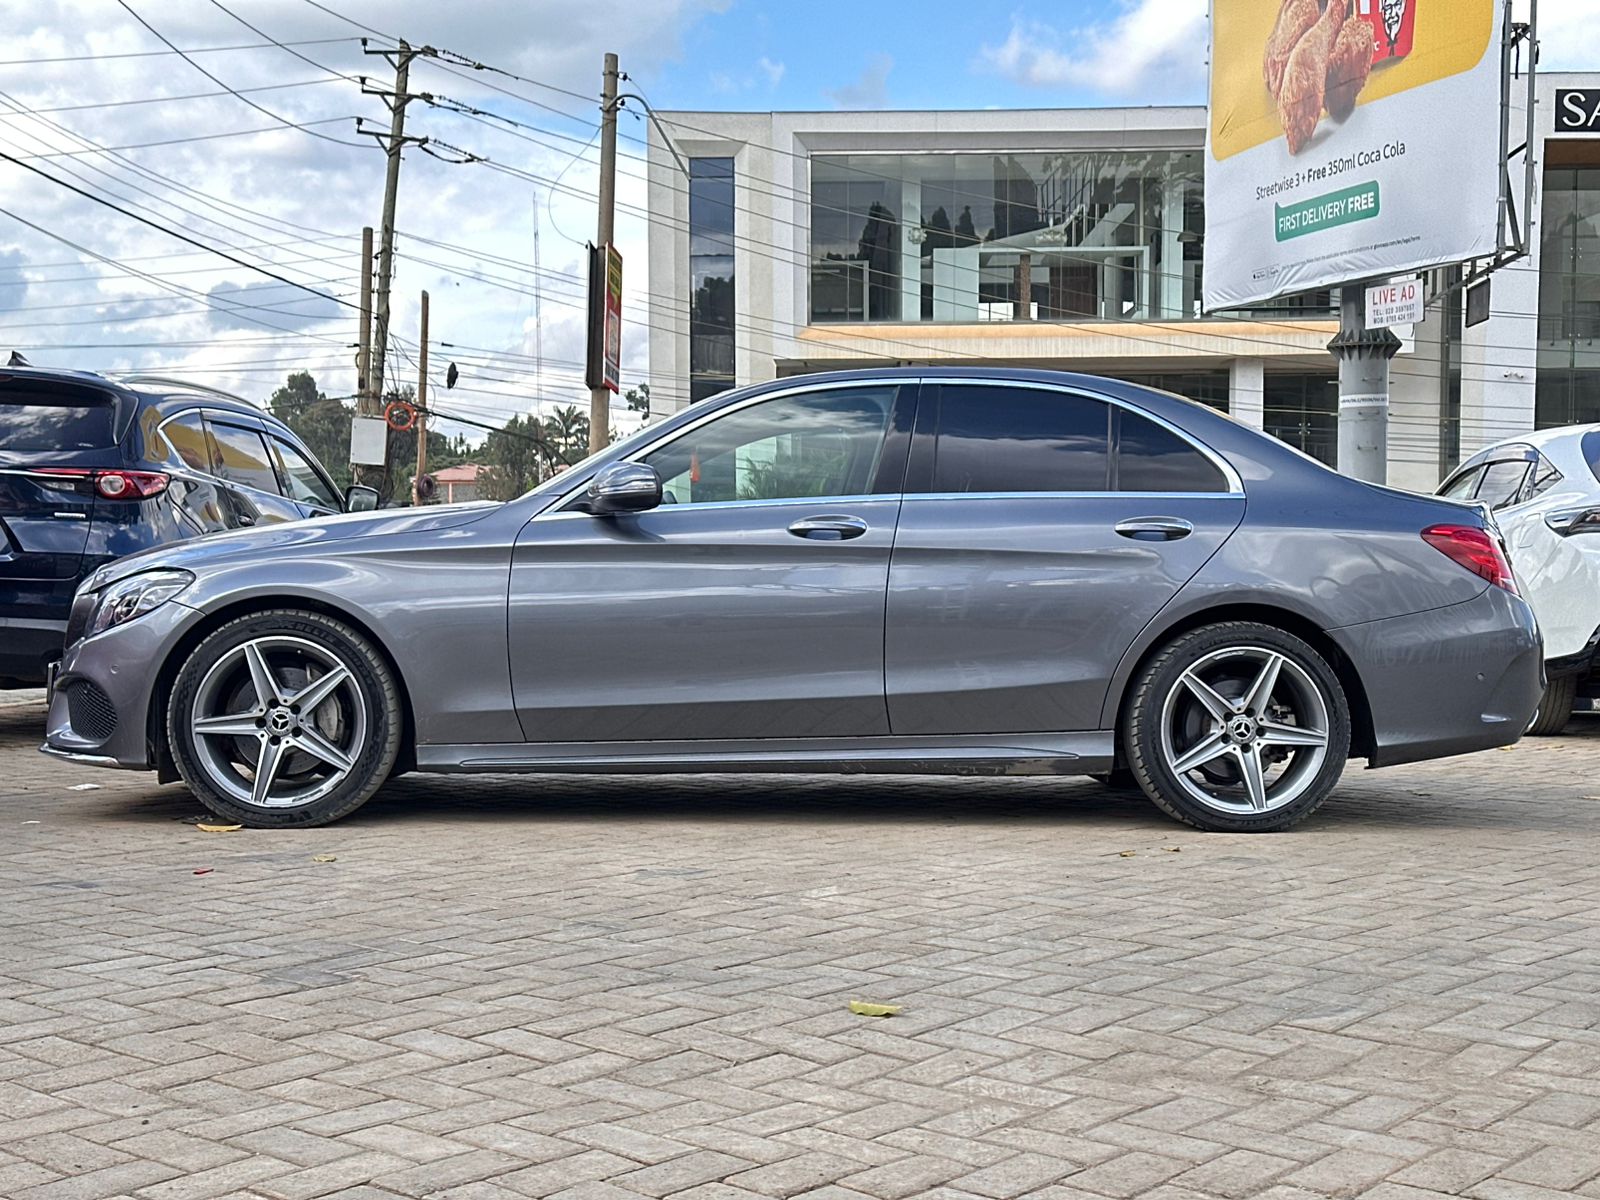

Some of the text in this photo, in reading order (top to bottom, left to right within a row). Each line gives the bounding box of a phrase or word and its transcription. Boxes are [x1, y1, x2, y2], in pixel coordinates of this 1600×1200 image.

[1256, 141, 1406, 200] Streetwise 3 + Free 350ml Coca Cola
[1278, 191, 1375, 233] FIRST DELIVERY FREE
[1372, 285, 1415, 306] LIVE AD
